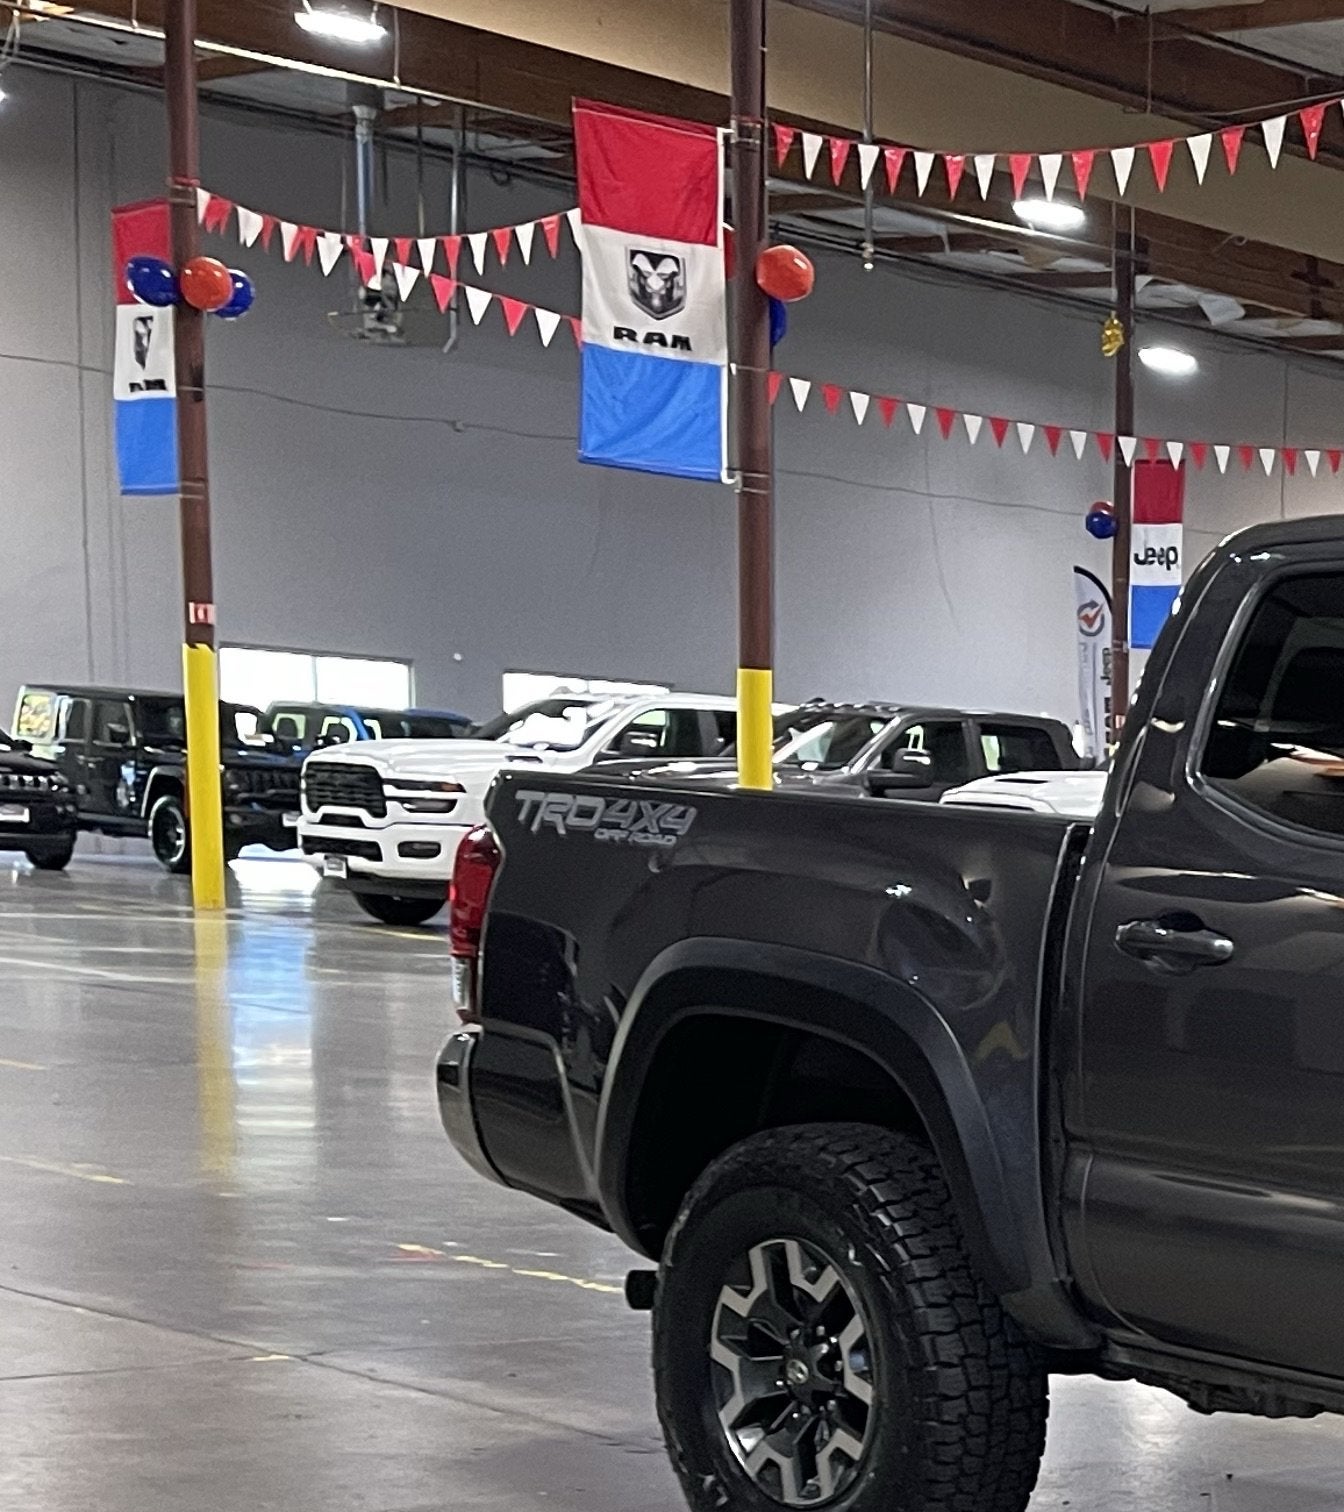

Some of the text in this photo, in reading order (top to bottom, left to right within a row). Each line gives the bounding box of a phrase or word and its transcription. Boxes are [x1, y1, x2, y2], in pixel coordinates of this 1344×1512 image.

[613, 326, 693, 351] RAM
[1133, 546, 1178, 571] Jeep
[515, 790, 606, 835] TRD
